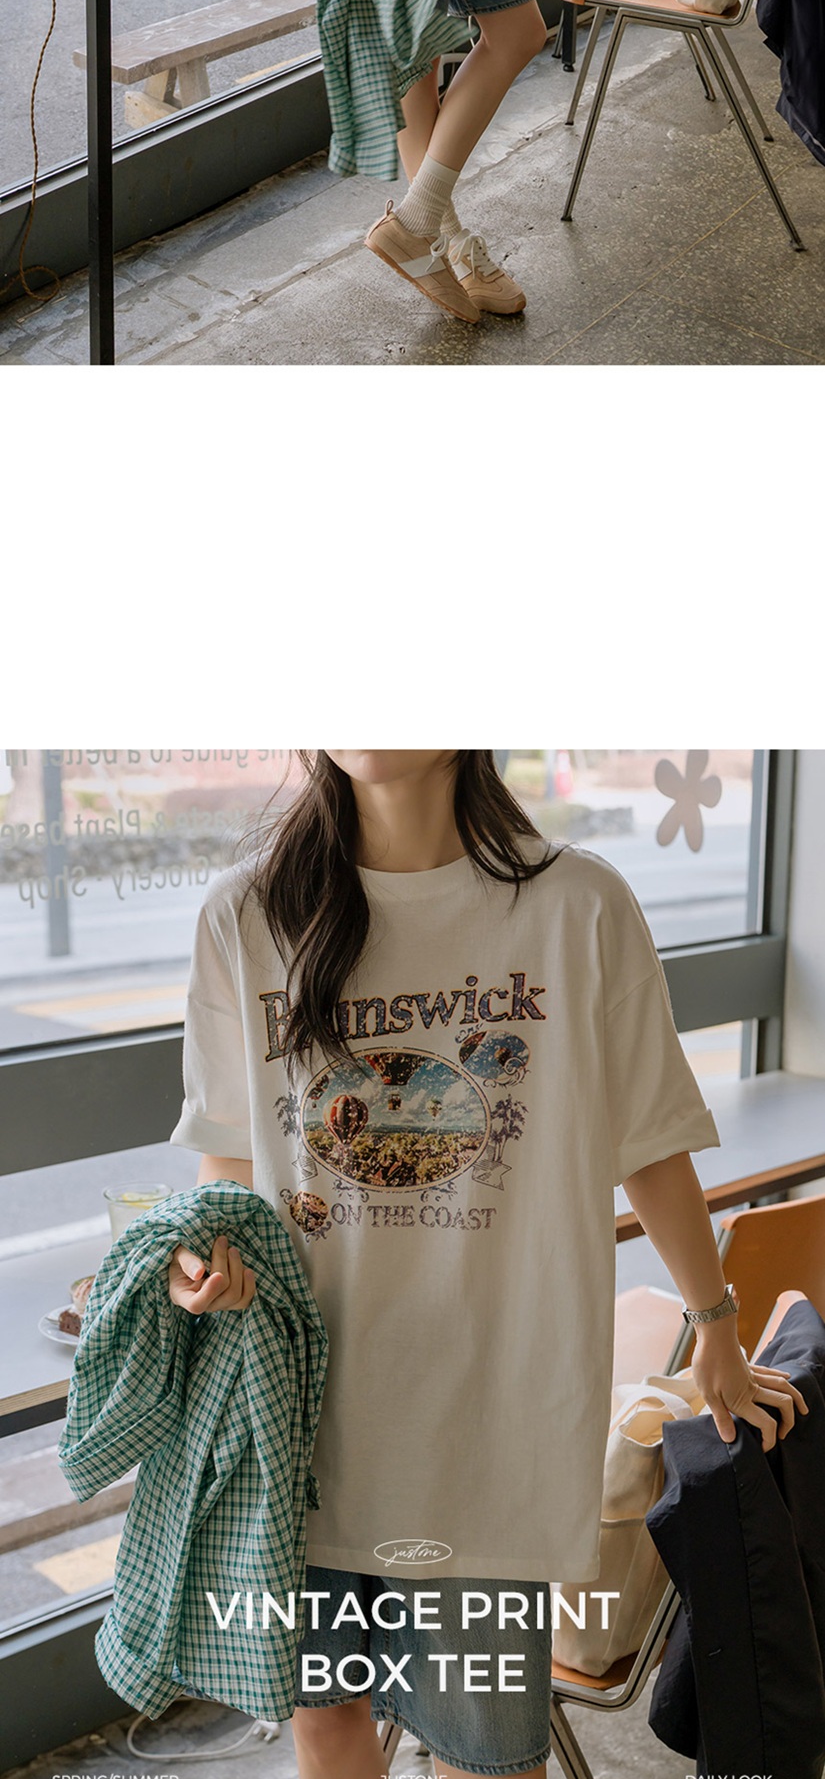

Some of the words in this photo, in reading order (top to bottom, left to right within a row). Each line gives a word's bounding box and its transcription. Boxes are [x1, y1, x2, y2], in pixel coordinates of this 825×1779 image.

[259, 972, 547, 1062] Bunswick
[331, 1203, 364, 1226] ON
[367, 1204, 416, 1229] THE
[419, 1205, 497, 1231] COAST
